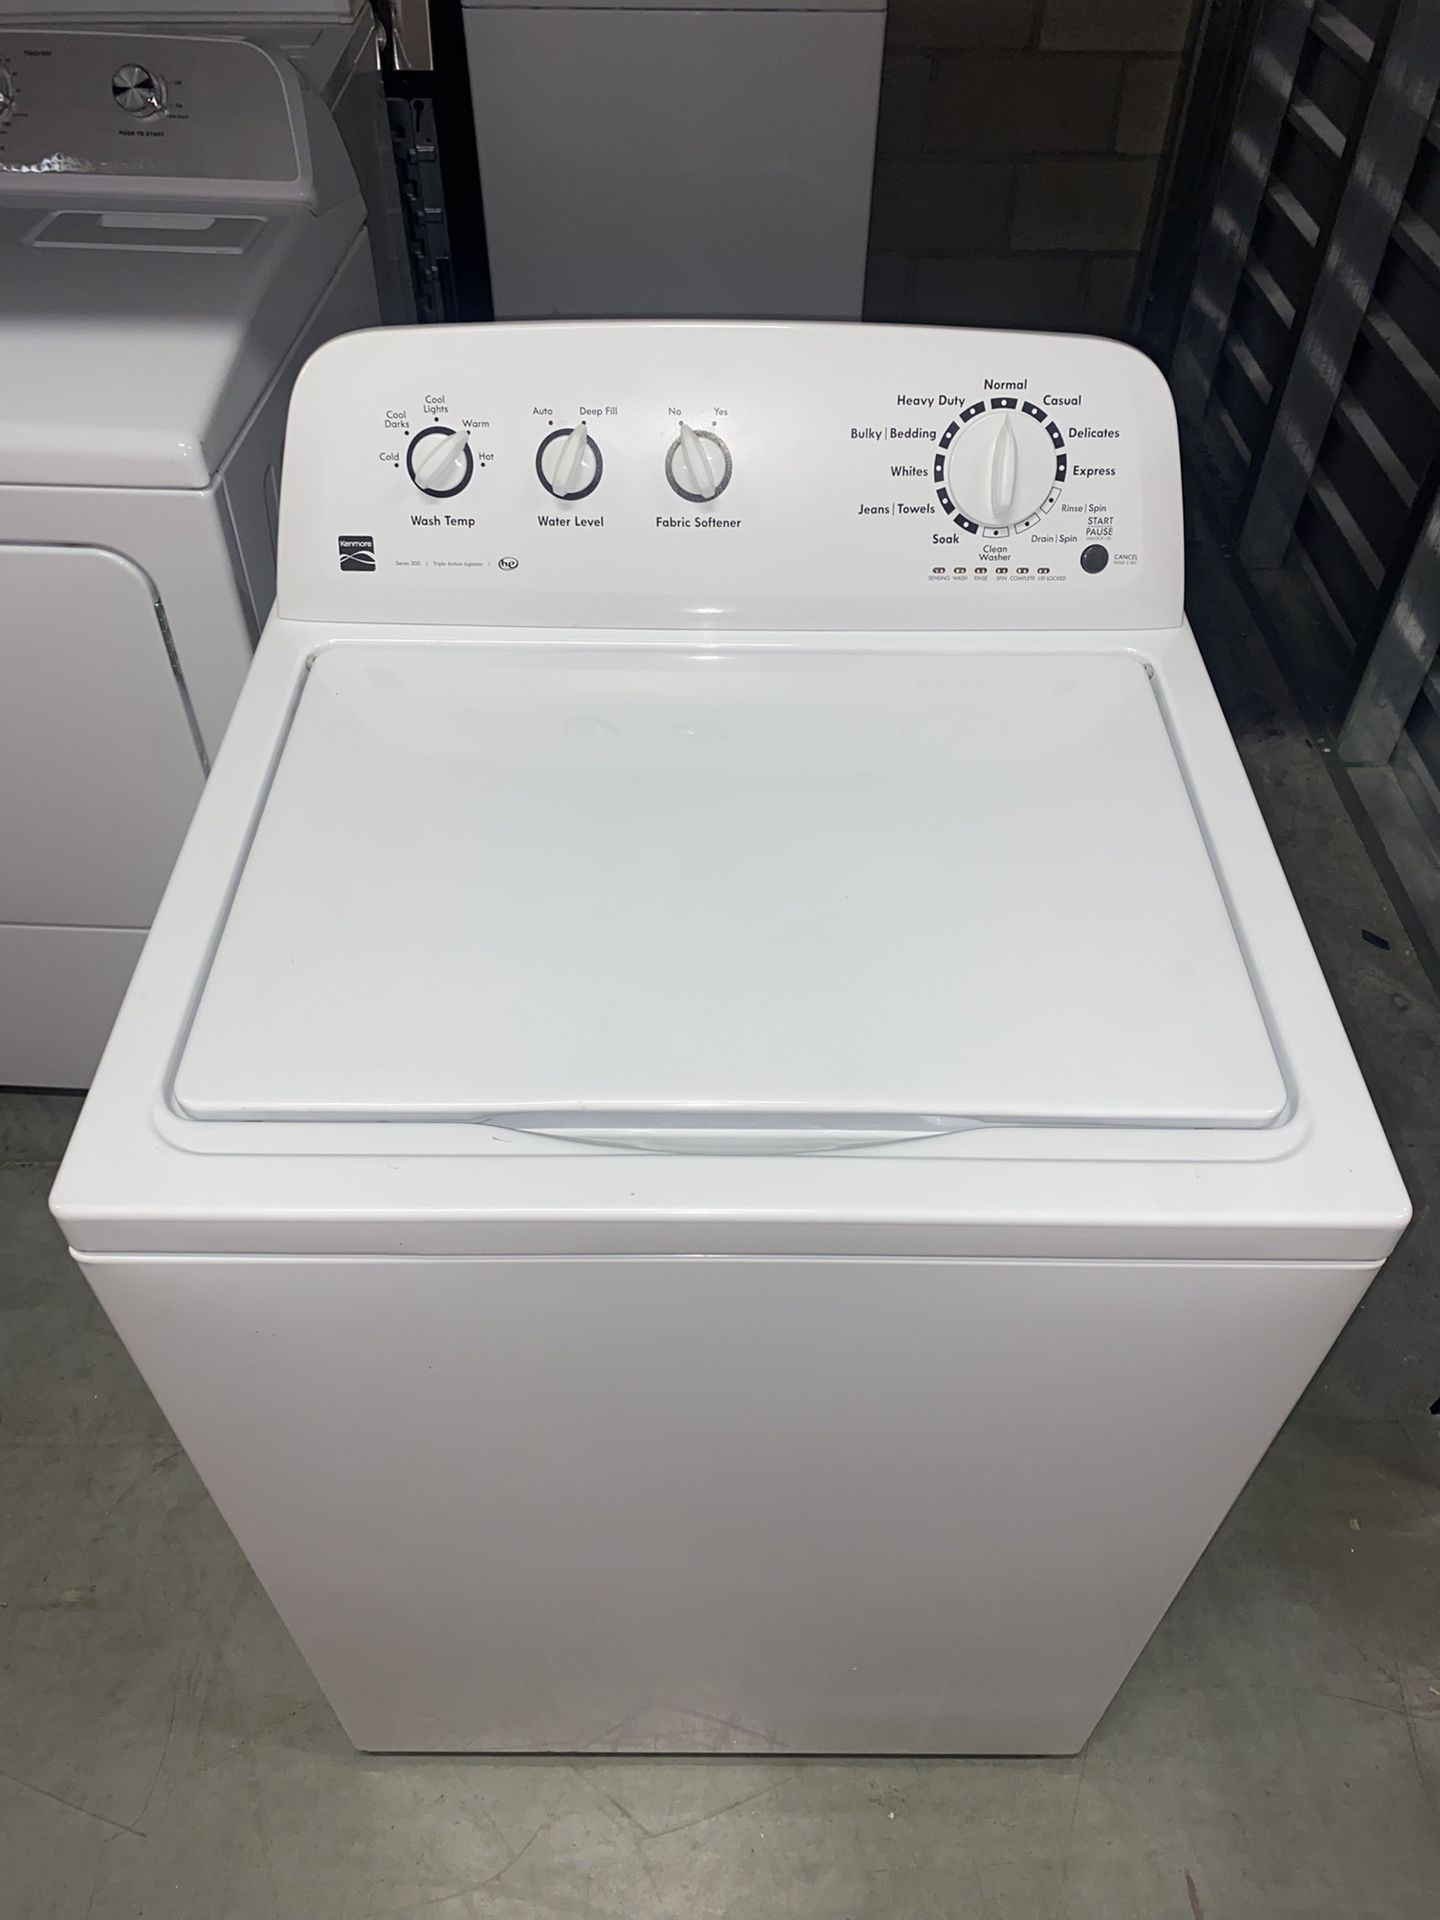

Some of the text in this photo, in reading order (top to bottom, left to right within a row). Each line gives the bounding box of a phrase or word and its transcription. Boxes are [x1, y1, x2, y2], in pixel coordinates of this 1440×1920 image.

[984, 379, 1027, 390] Normal
[425, 395, 445, 404] Cool
[897, 395, 966, 408] Heavy Duty
[1043, 395, 1082, 406] Casual
[385, 410, 407, 419] Cool
[423, 404, 449, 415] Lights
[532, 407, 553, 415] Auto
[579, 407, 618, 417] Deep Fill
[668, 407, 682, 415] No
[713, 407, 728, 417] Yes
[384, 419, 410, 428] Darks
[462, 419, 490, 428] Warm
[850, 428, 937, 441] Bulky Bedding
[1068, 428, 1120, 439] Delicates
[379, 452, 400, 461] Cold
[479, 452, 494, 461] Hot
[891, 466, 928, 477] Whites
[1073, 466, 1116, 477] Express
[858, 504, 935, 515] Jeans Towels
[1061, 504, 1107, 514] Rinse Spin
[410, 515, 476, 529] Wash Temp
[537, 516, 604, 527] Water Level
[656, 516, 741, 528] Fabric Softener
[1088, 517, 1114, 525] START
[1086, 527, 1113, 536] PAUSE
[932, 534, 959, 544] Soak
[1031, 534, 1078, 544] Drain Spin
[982, 545, 1008, 553] Clean
[979, 553, 1011, 561] Washer
